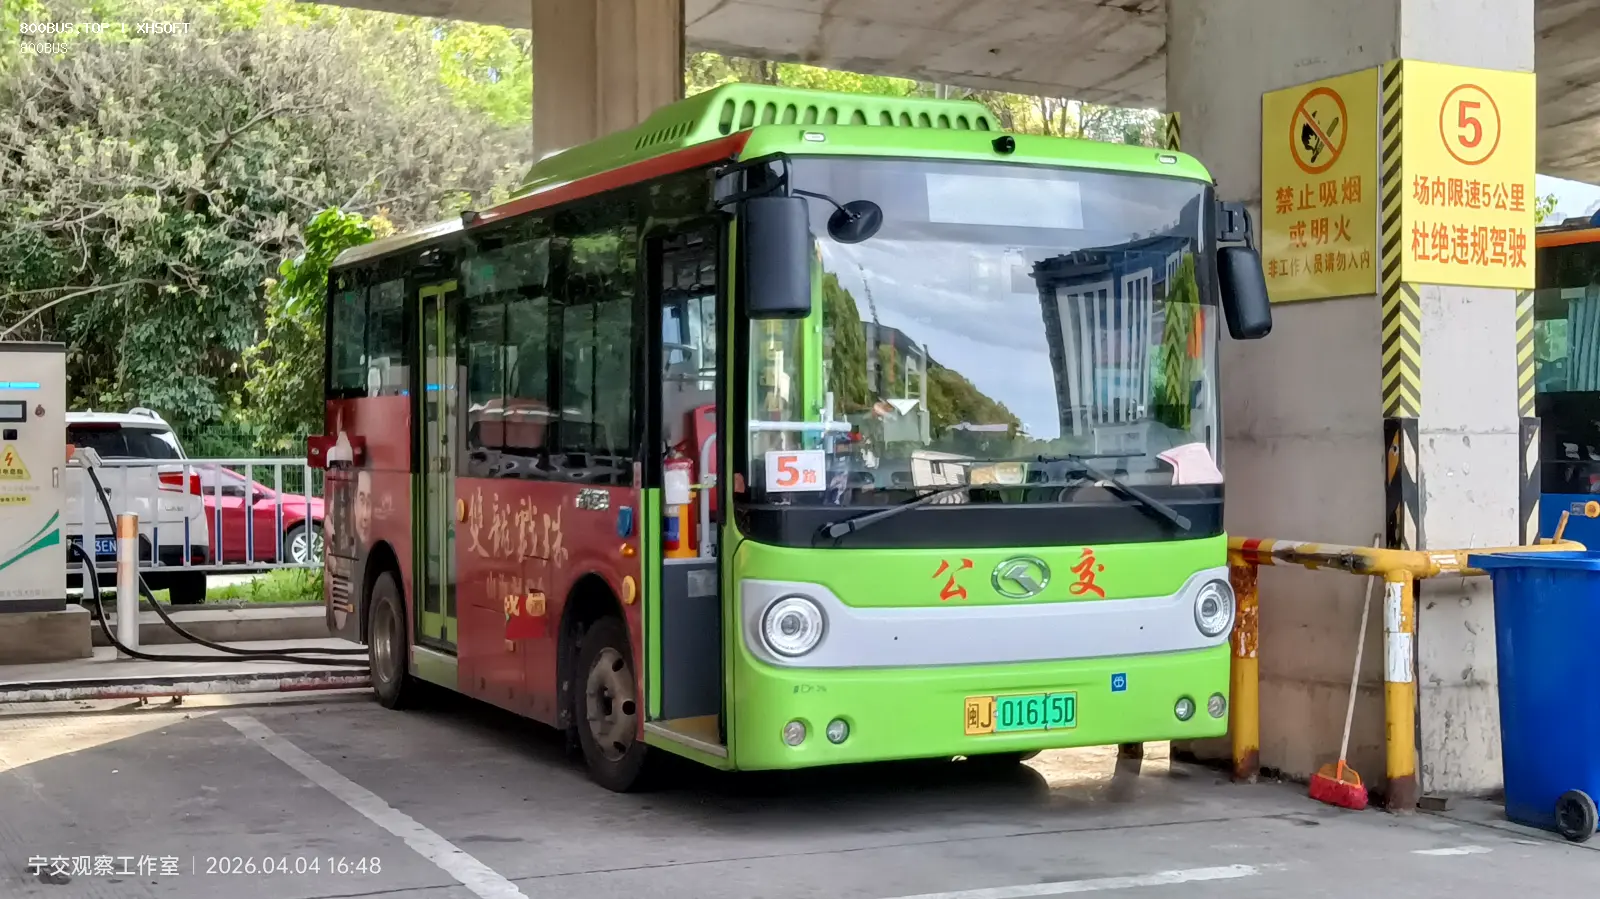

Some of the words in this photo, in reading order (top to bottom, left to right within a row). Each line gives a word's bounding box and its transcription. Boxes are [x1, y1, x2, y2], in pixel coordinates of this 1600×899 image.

[1457, 99, 1483, 148] 5
[1275, 175, 1362, 215] 禁止吸烟
[1412, 173, 1526, 213] 场内限速5公里
[1288, 213, 1353, 249] 或明火
[1411, 219, 1527, 268] 杜绝违规驾驶
[1268, 247, 1371, 280] 非工作人员请勿入内
[776, 455, 817, 488] 5路
[931, 557, 974, 601] 公
[1068, 547, 1106, 599] 交
[1001, 696, 1076, 728] 01615D
